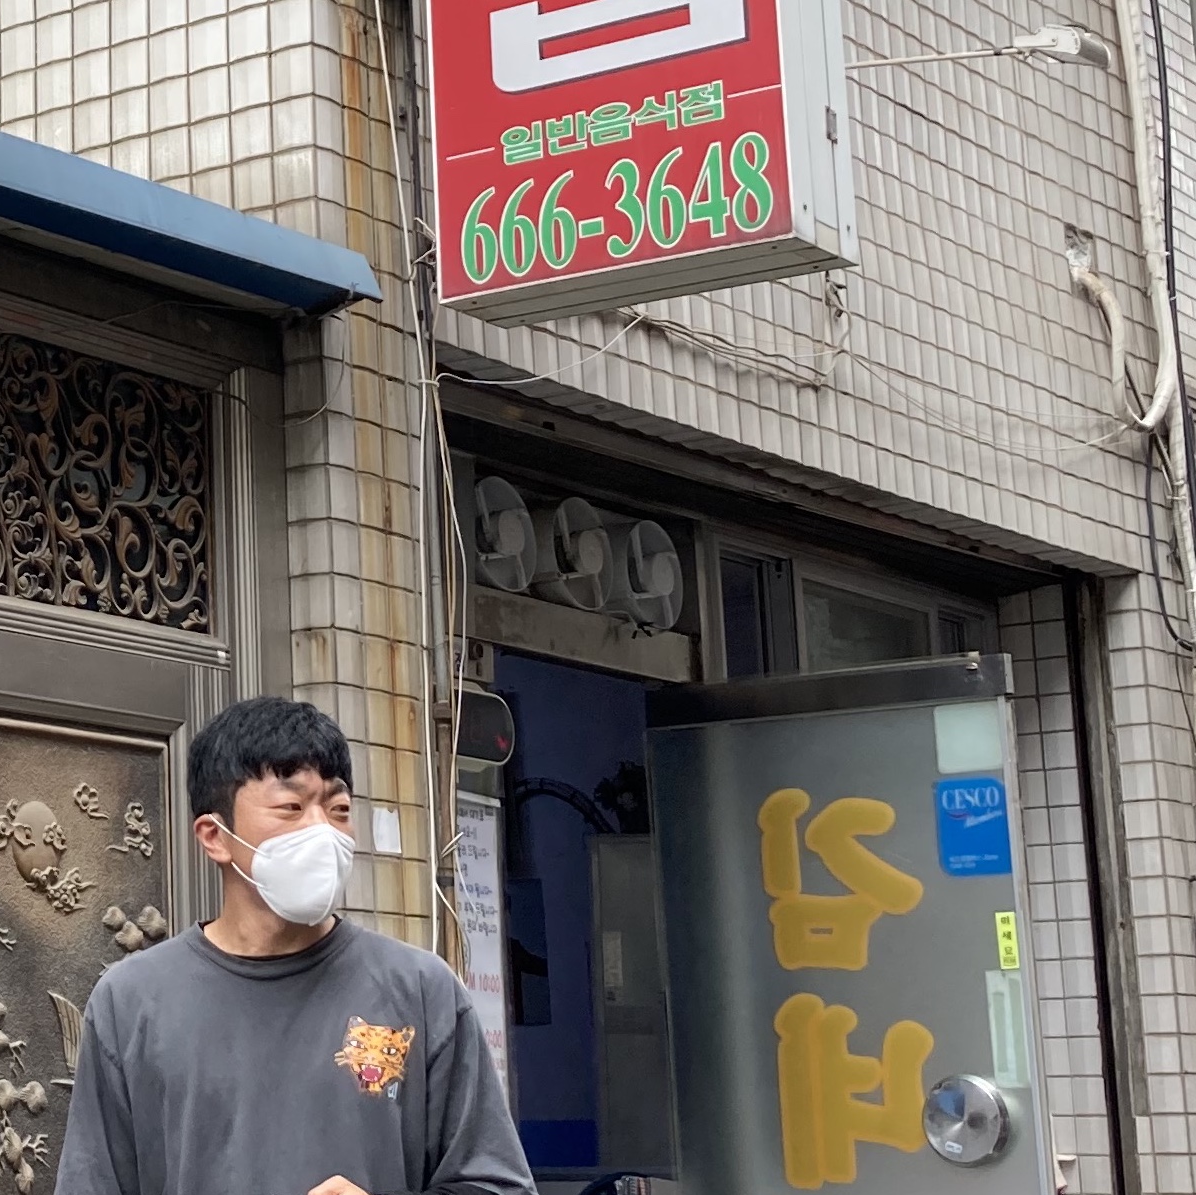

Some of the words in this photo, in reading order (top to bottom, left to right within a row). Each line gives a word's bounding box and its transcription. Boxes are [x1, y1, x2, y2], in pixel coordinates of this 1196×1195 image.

[500, 80, 725, 165] 일반음식점
[461, 131, 773, 284] 666-3648
[942, 786, 999, 810] CESCO
